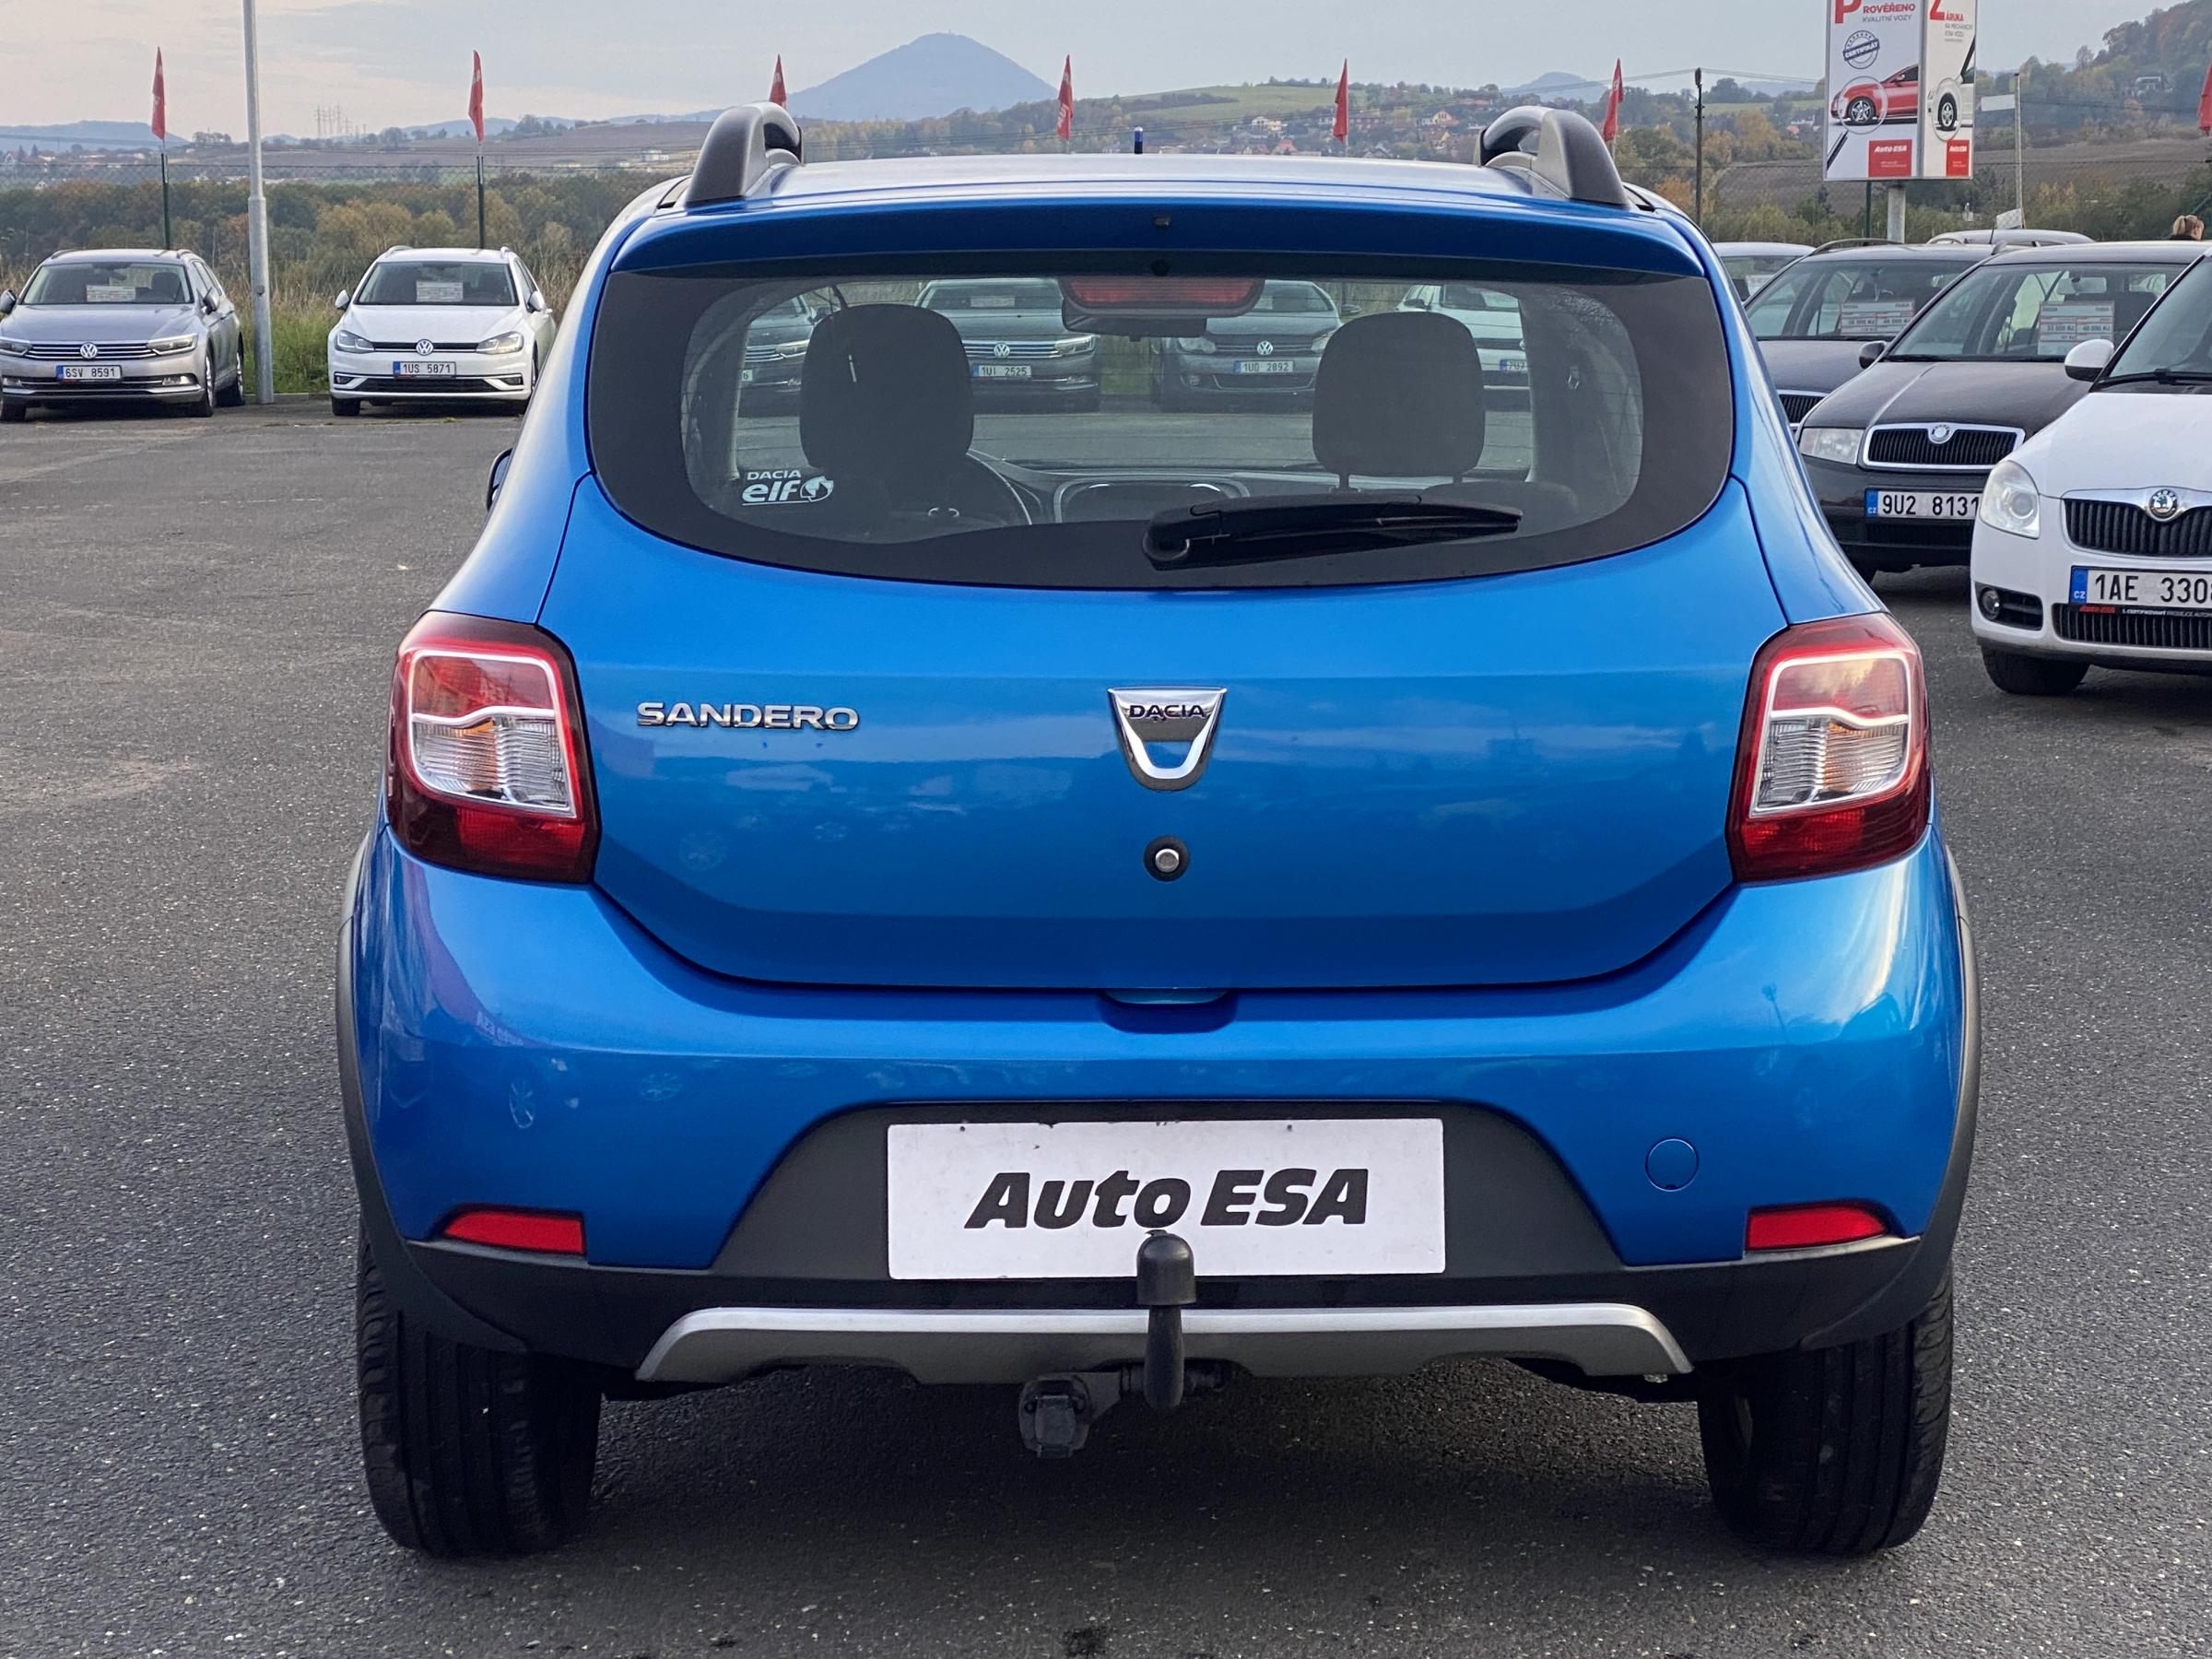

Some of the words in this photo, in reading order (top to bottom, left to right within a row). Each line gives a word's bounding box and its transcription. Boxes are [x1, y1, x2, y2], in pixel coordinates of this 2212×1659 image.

[65, 368, 83, 378] 6SV
[91, 368, 115, 378] 8591
[403, 363, 420, 374] 1US
[427, 363, 451, 374] 5871
[747, 470, 802, 480] DACIA
[742, 479, 802, 502] elf
[1882, 494, 1916, 515] 9U2
[1932, 495, 1980, 516] 8131
[2074, 591, 2086, 599] CZ
[2095, 573, 2139, 601] 1AE
[2160, 576, 2212, 604] 330
[637, 702, 859, 731] SANDERO
[1129, 704, 1206, 718] DACIA
[964, 1171, 1191, 1230] Auto
[1200, 1168, 1369, 1227] ESA
